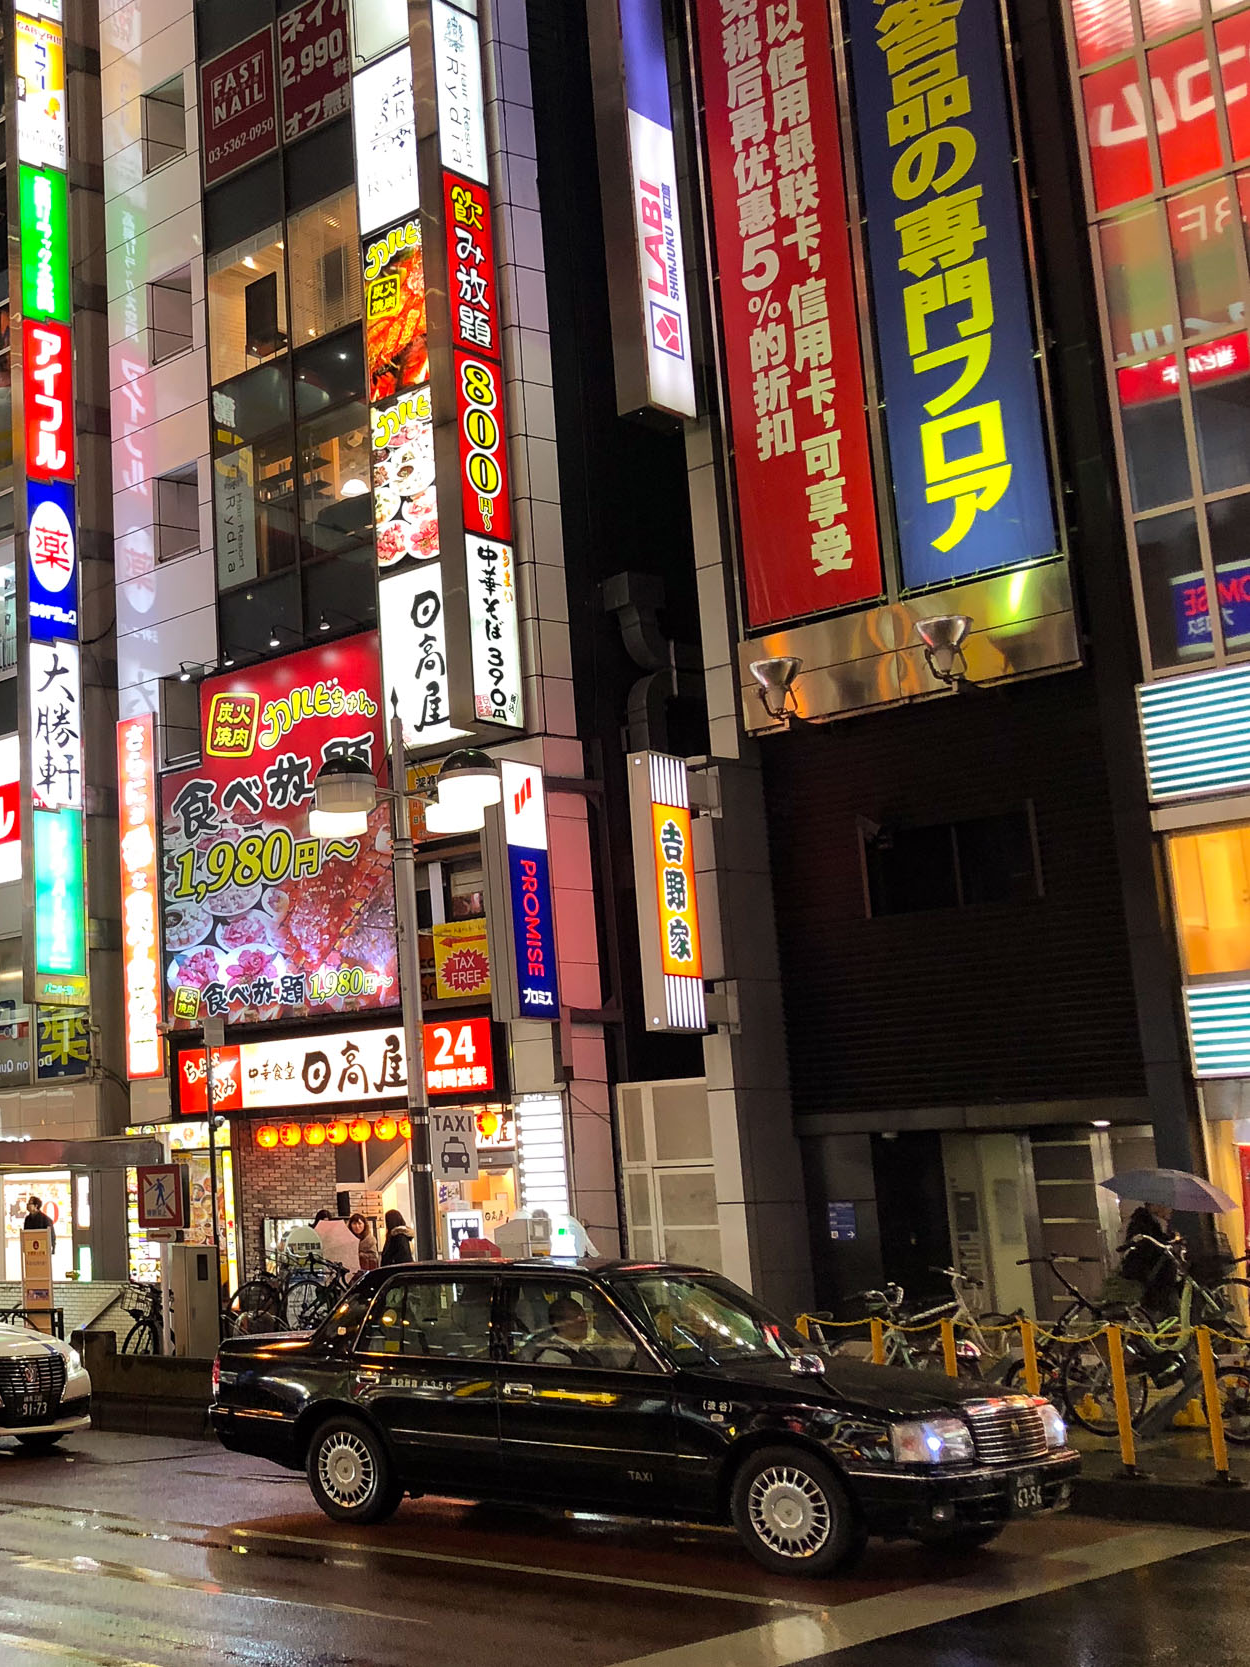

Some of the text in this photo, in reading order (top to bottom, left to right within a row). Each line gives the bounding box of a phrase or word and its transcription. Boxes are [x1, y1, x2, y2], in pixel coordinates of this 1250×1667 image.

[213, 56, 262, 100] FAST
[213, 90, 264, 125] NAIL
[445, 54, 463, 164] Rydia
[208, 116, 274, 165] 03-5362-0950
[638, 180, 669, 298] LABI
[665, 225, 680, 301] SHINJUKU
[451, 185, 492, 349] 飲み放題
[32, 328, 66, 470] アイフル
[35, 526, 71, 572] 薬
[224, 495, 237, 573] Rydia
[410, 588, 449, 733] 日高屋
[257, 678, 377, 751] カルビちゃん
[520, 859, 545, 978] PROMISE
[451, 970, 482, 985] FREE
[453, 956, 476, 971] TAX
[522, 987, 554, 1006] プロミス
[301, 1033, 408, 1095] 日高屋
[433, 1025, 477, 1066] 24
[432, 1114, 473, 1133] TAXI
[627, 1471, 654, 1483] TAXI
